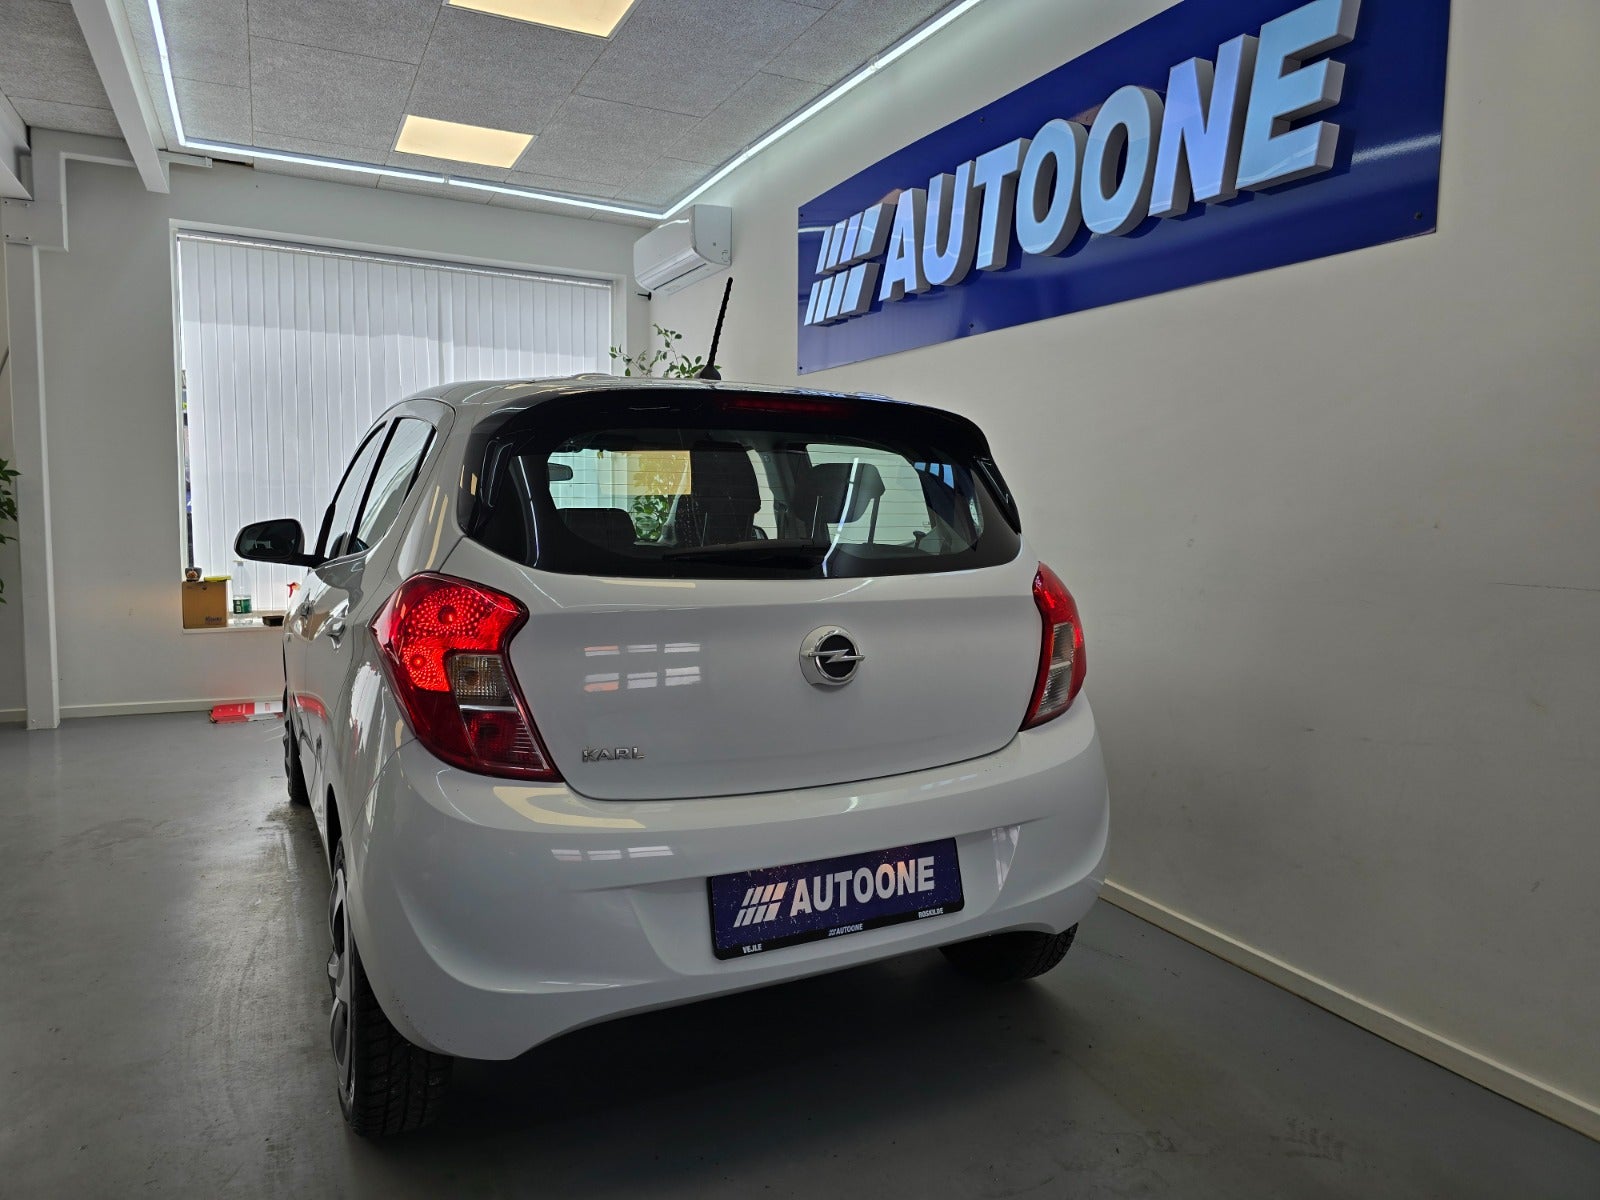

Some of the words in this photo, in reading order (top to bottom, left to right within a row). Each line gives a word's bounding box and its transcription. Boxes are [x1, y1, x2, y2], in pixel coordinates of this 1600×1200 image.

[879, 0, 1358, 301] AUTOONE
[582, 747, 645, 762] KARL
[790, 856, 935, 917] AUTOONE
[918, 907, 944, 918] ROSKILDE
[835, 923, 863, 935] AUTOONE
[742, 943, 762, 954] VEJLE
